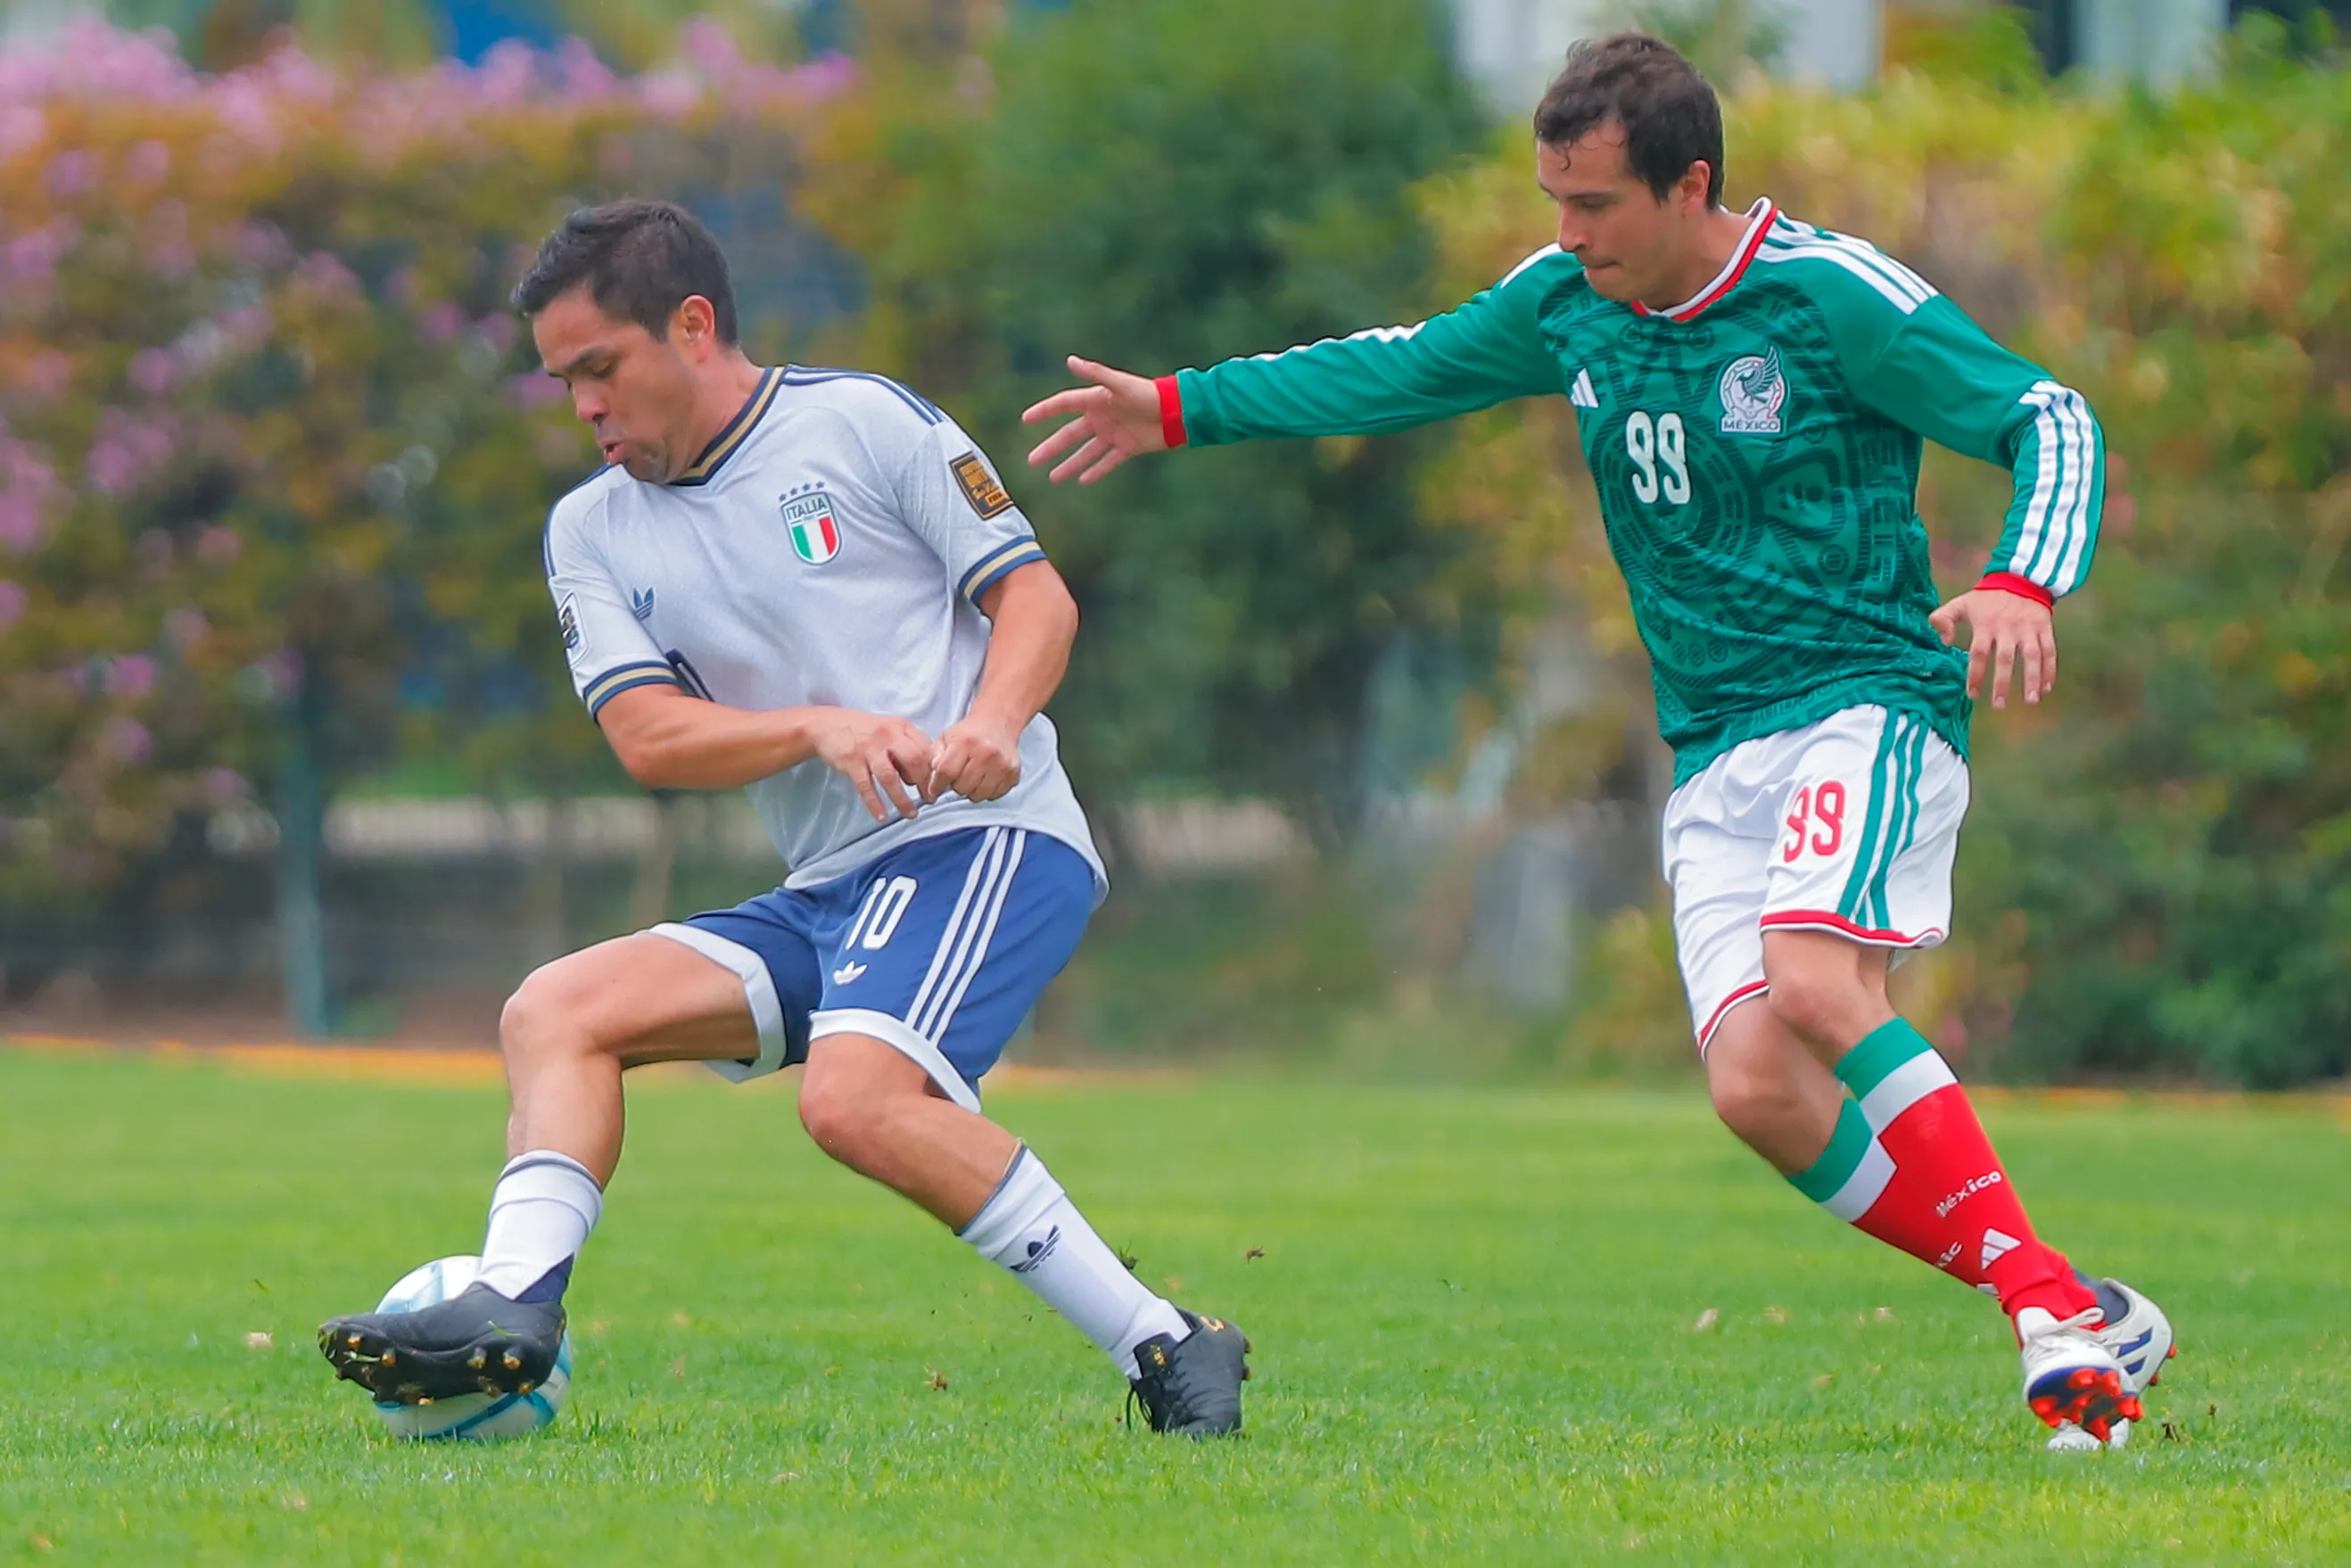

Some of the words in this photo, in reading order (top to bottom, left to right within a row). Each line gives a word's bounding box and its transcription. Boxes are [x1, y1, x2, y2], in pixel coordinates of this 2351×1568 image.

[1626, 410, 1691, 504] 99
[786, 497, 829, 520] ITALIA
[1783, 780, 1844, 862] 99
[846, 875, 918, 950] 10
